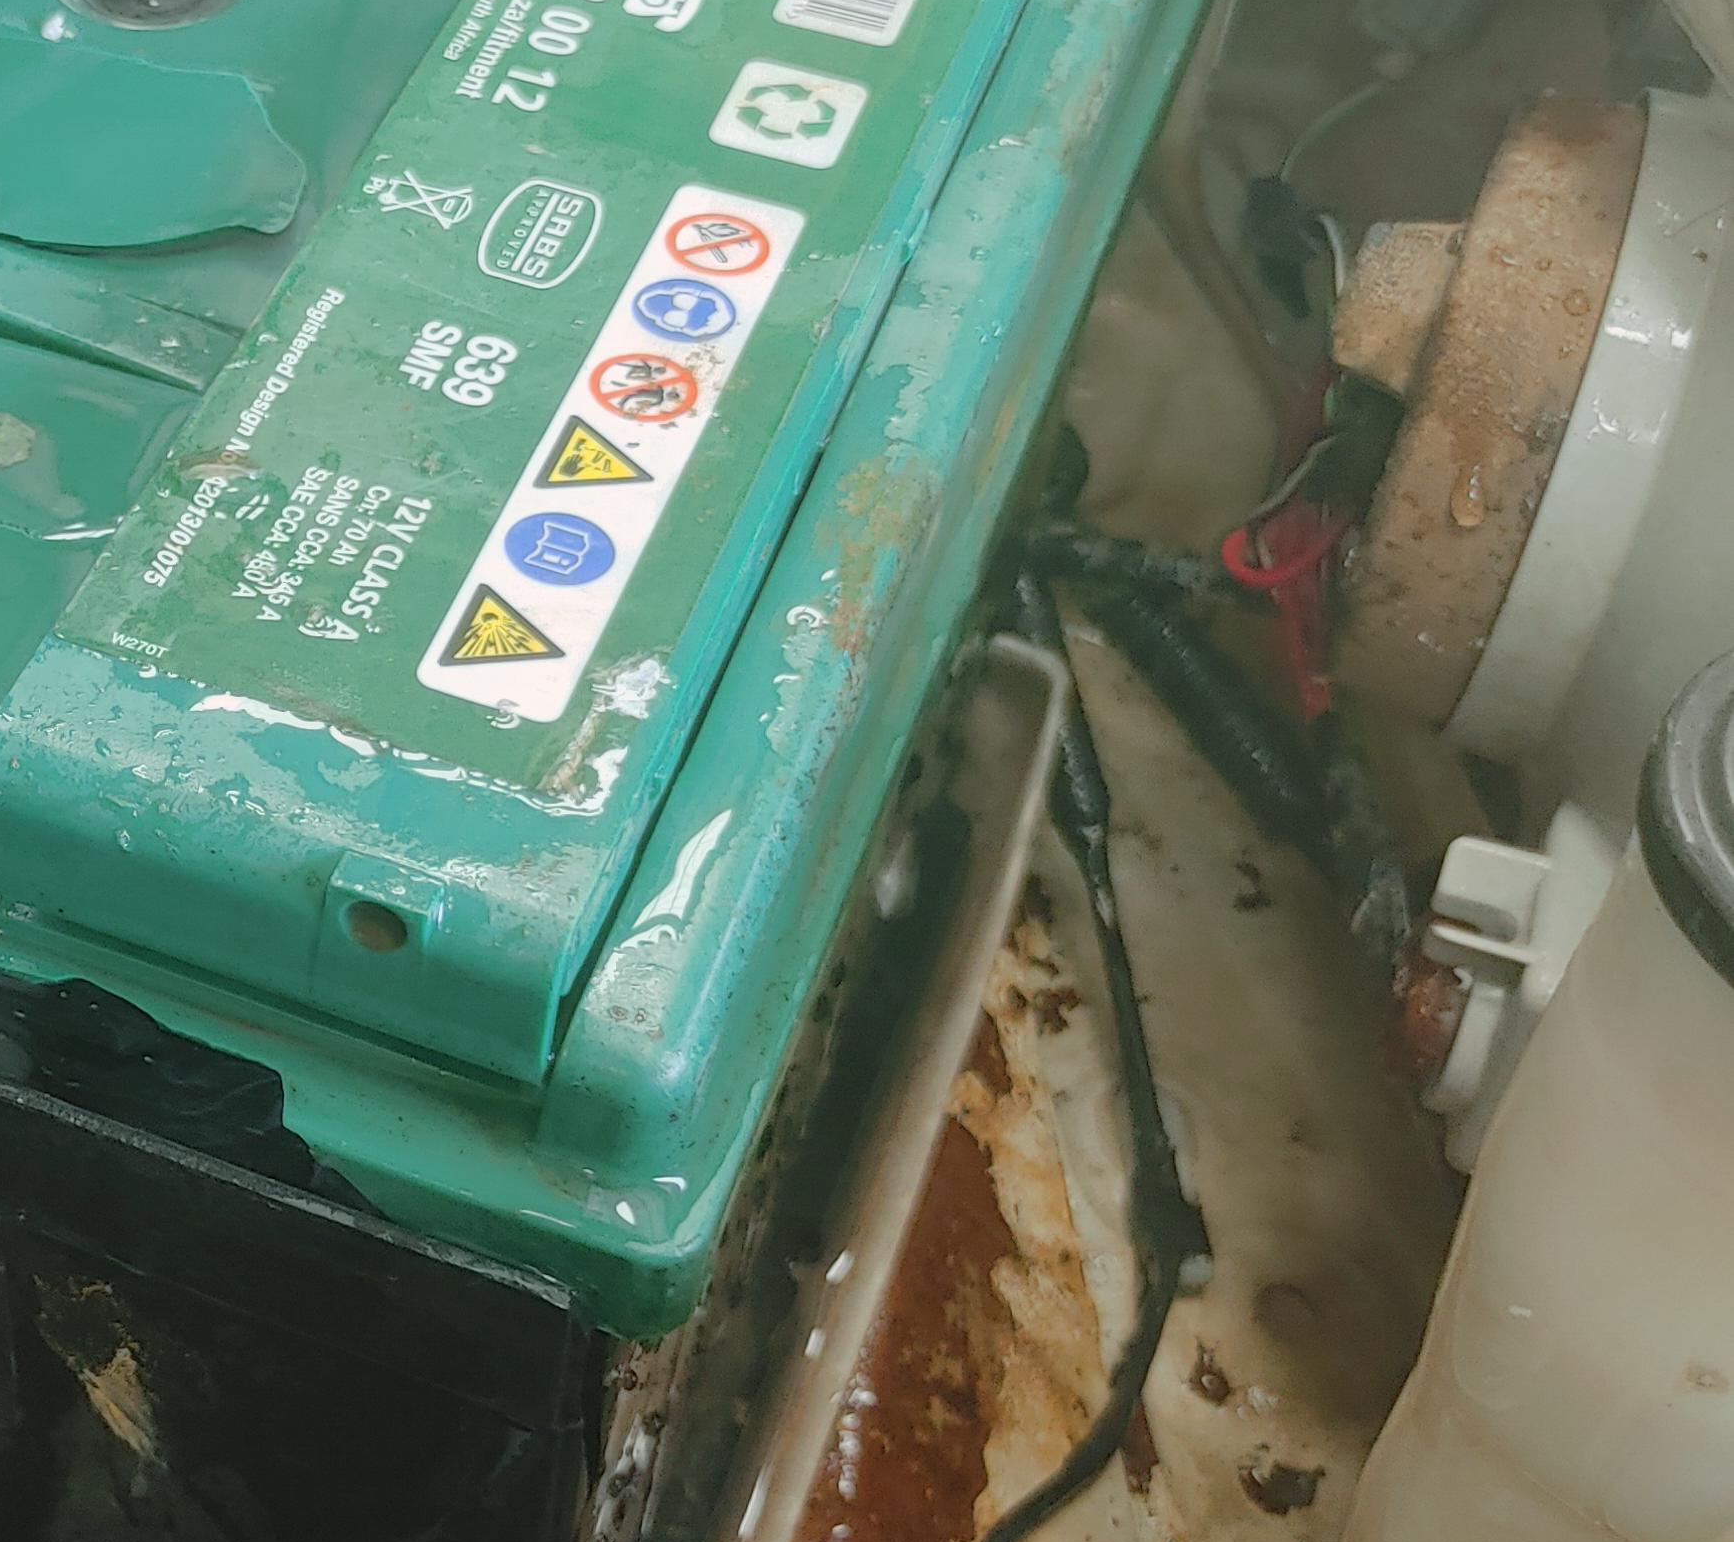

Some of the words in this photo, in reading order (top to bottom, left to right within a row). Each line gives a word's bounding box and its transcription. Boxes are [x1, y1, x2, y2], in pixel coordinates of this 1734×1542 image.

[443, 18, 483, 61] Africa
[528, 8, 592, 56] 00
[491, 65, 556, 112] 12
[362, 176, 387, 194] Pb
[496, 188, 551, 269] APPROVED
[521, 195, 584, 278] SABS
[274, 287, 346, 379] Registered
[398, 321, 462, 391] SMF
[441, 335, 517, 407] 639
[236, 377, 289, 438] Design
[290, 466, 332, 506] SAE
[315, 475, 360, 527] SANS
[357, 485, 392, 516] Cn:
[263, 505, 305, 548] CCA:
[344, 517, 373, 541] 70
[385, 496, 433, 544] 12V
[288, 527, 330, 571] CCA:
[328, 540, 360, 566] Ah
[231, 582, 258, 599] A
[267, 571, 303, 607] 345
[341, 543, 405, 619] CLASS
[256, 605, 282, 622] A
[323, 617, 360, 641] A
[111, 631, 169, 658] W270T
